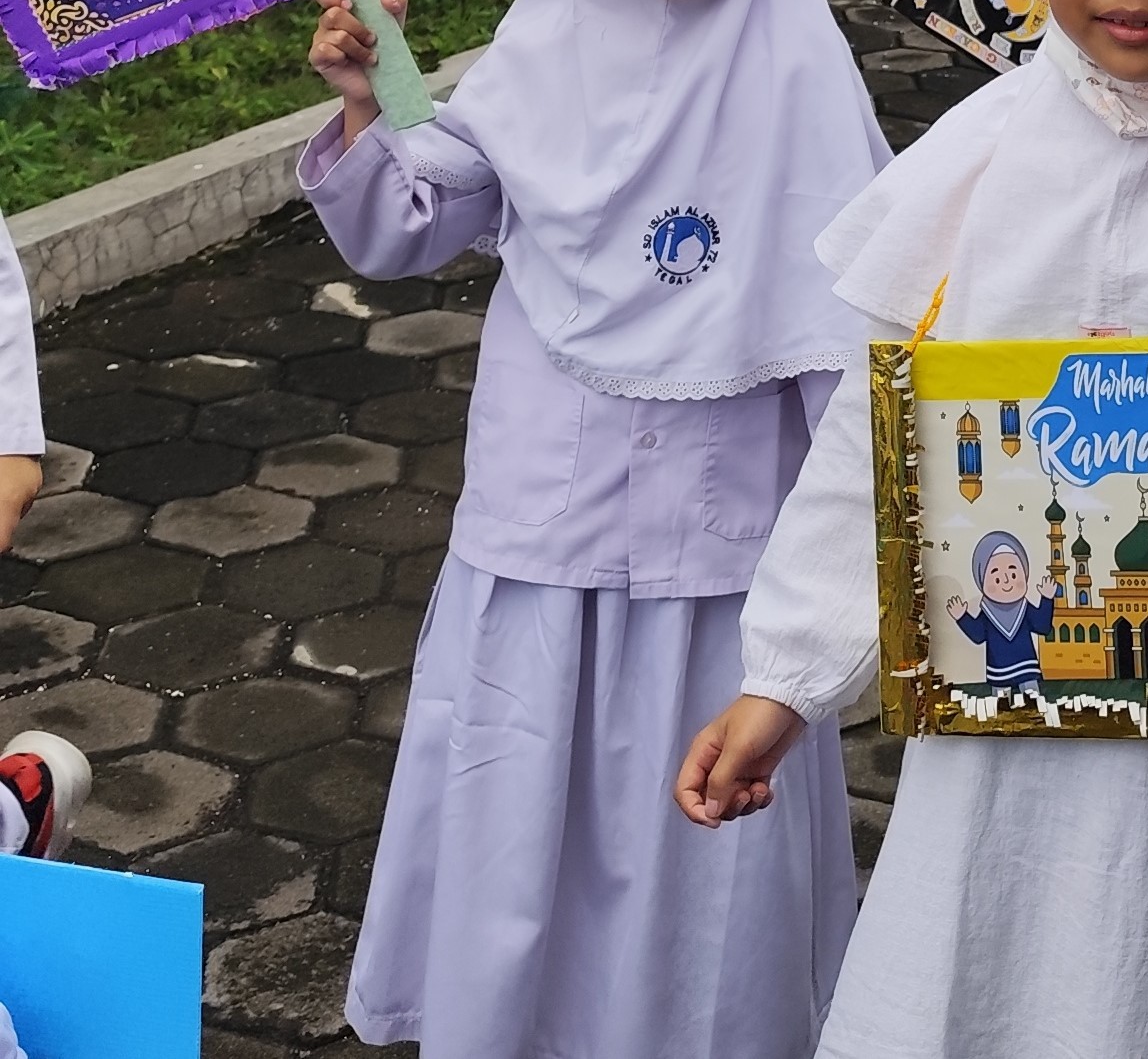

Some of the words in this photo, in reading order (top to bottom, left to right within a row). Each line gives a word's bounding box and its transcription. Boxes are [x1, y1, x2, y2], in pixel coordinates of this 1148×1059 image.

[647, 205, 681, 231] ISLAM
[684, 205, 700, 218] AL
[700, 212, 721, 246] AZHAR
[642, 233, 653, 250] SD
[706, 249, 719, 264] 72
[654, 267, 693, 286] TEGAL
